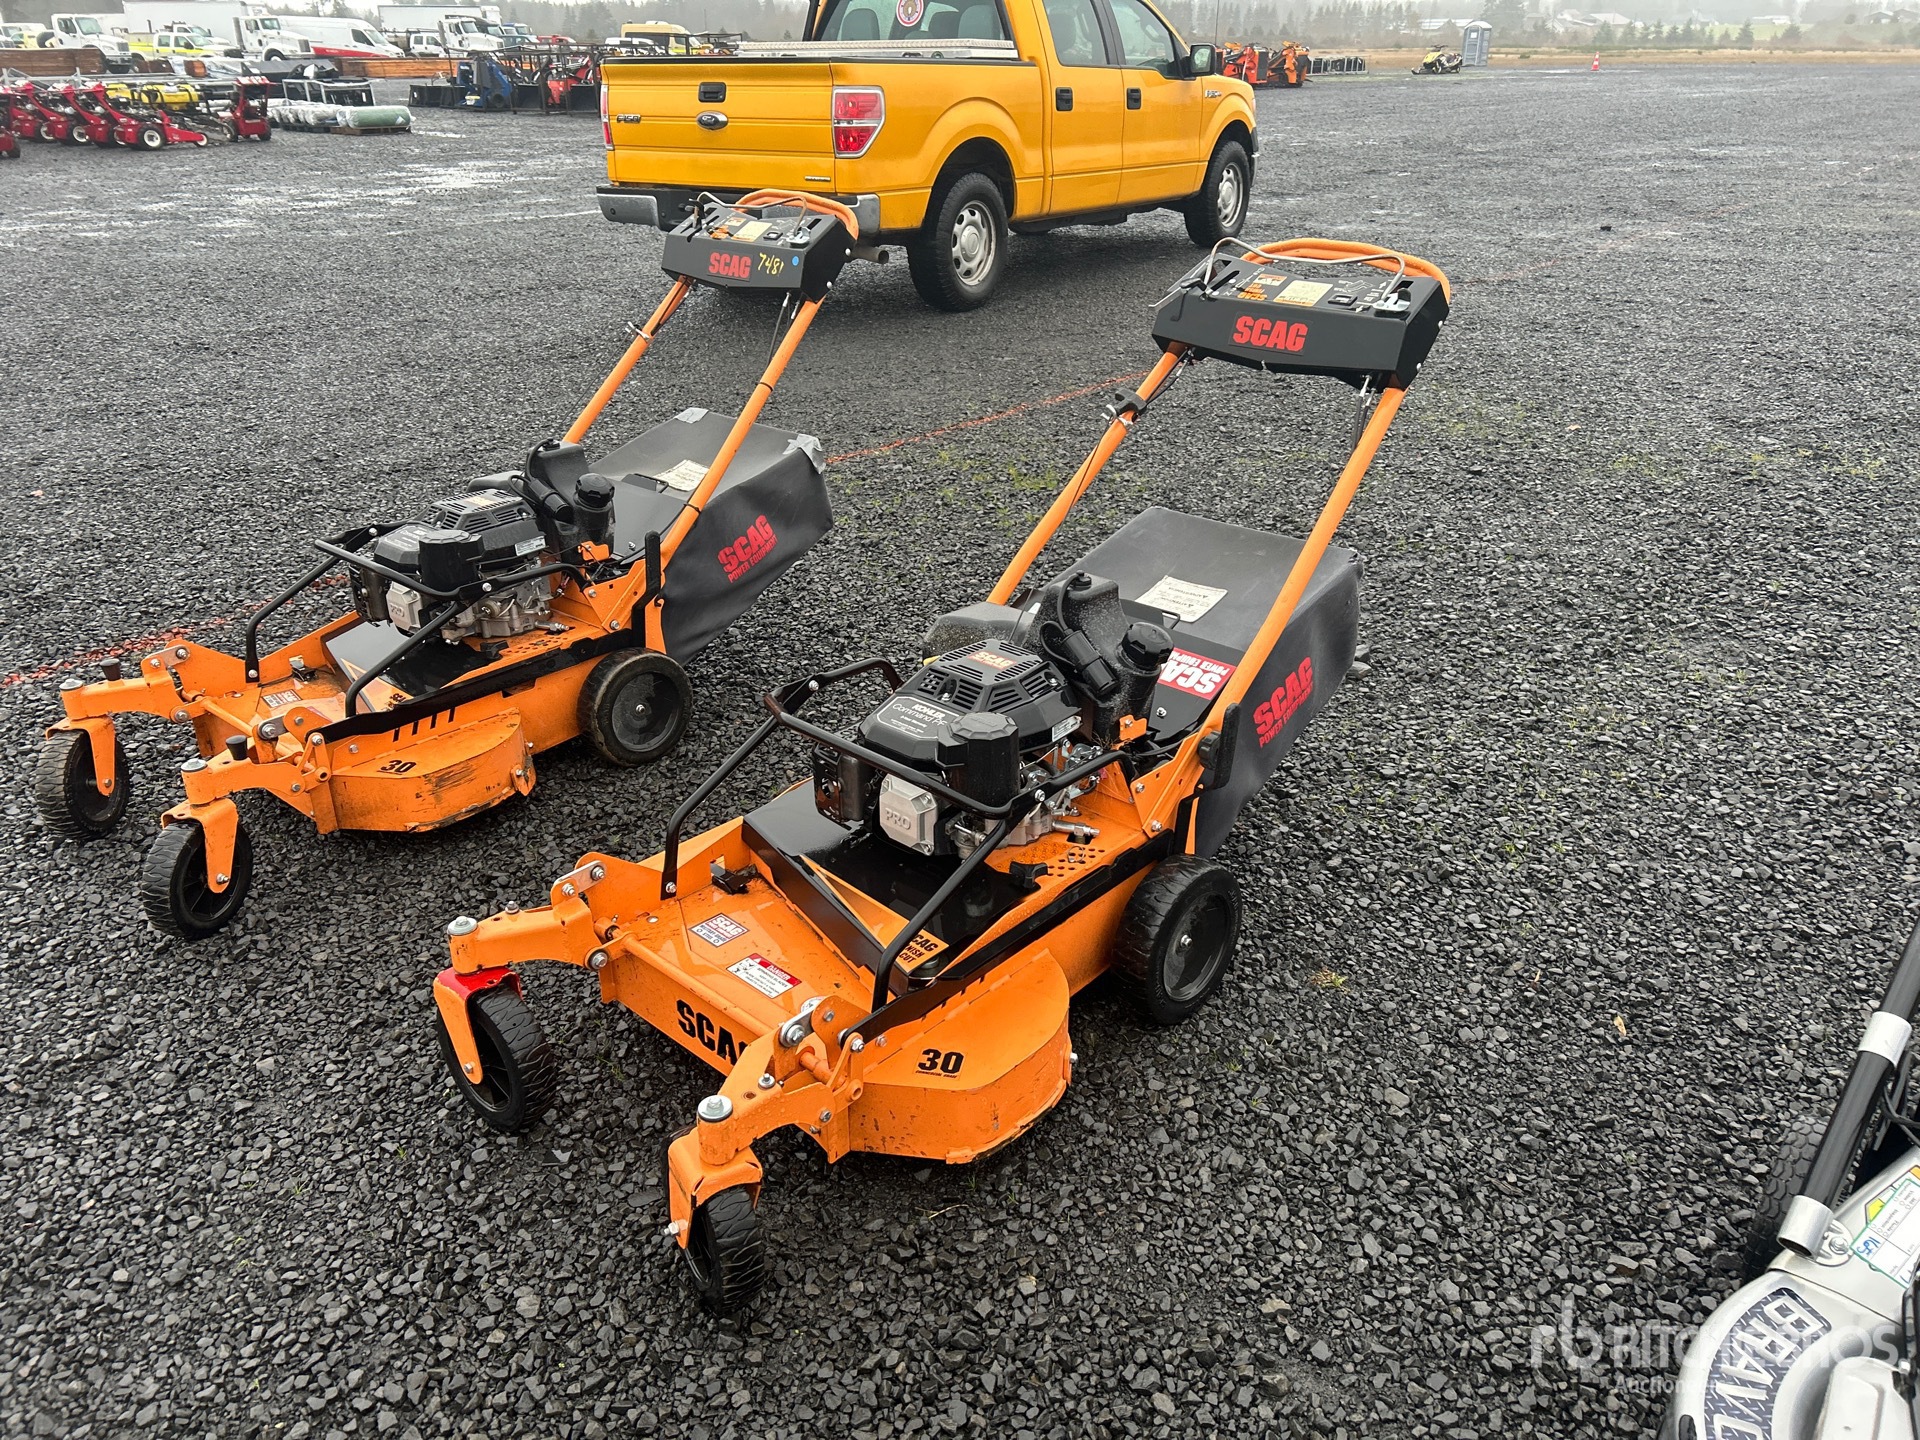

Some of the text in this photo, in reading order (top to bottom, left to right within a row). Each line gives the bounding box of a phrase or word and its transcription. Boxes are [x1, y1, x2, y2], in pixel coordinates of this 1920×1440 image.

[708, 252, 752, 279] SCAG
[1232, 315, 1309, 352] SCAG
[718, 514, 774, 573] SCAG
[727, 534, 778, 583] POWER EQUIPMENT
[1169, 651, 1230, 677] POWER EQUIPM
[1159, 661, 1222, 694] SCA
[1253, 656, 1313, 735] SCAG
[892, 703, 935, 722] Command
[911, 704, 946, 718] KOHLER
[1258, 719, 1283, 749] POWER
[380, 759, 417, 773] 30
[884, 807, 912, 830] PRO
[711, 916, 743, 936] SCAG
[904, 945, 926, 959] NISH
[911, 934, 939, 952] CAG
[899, 952, 917, 964] CUT
[767, 964, 791, 981] DANGER
[676, 999, 749, 1067] SCA
[917, 1048, 965, 1074] 30
